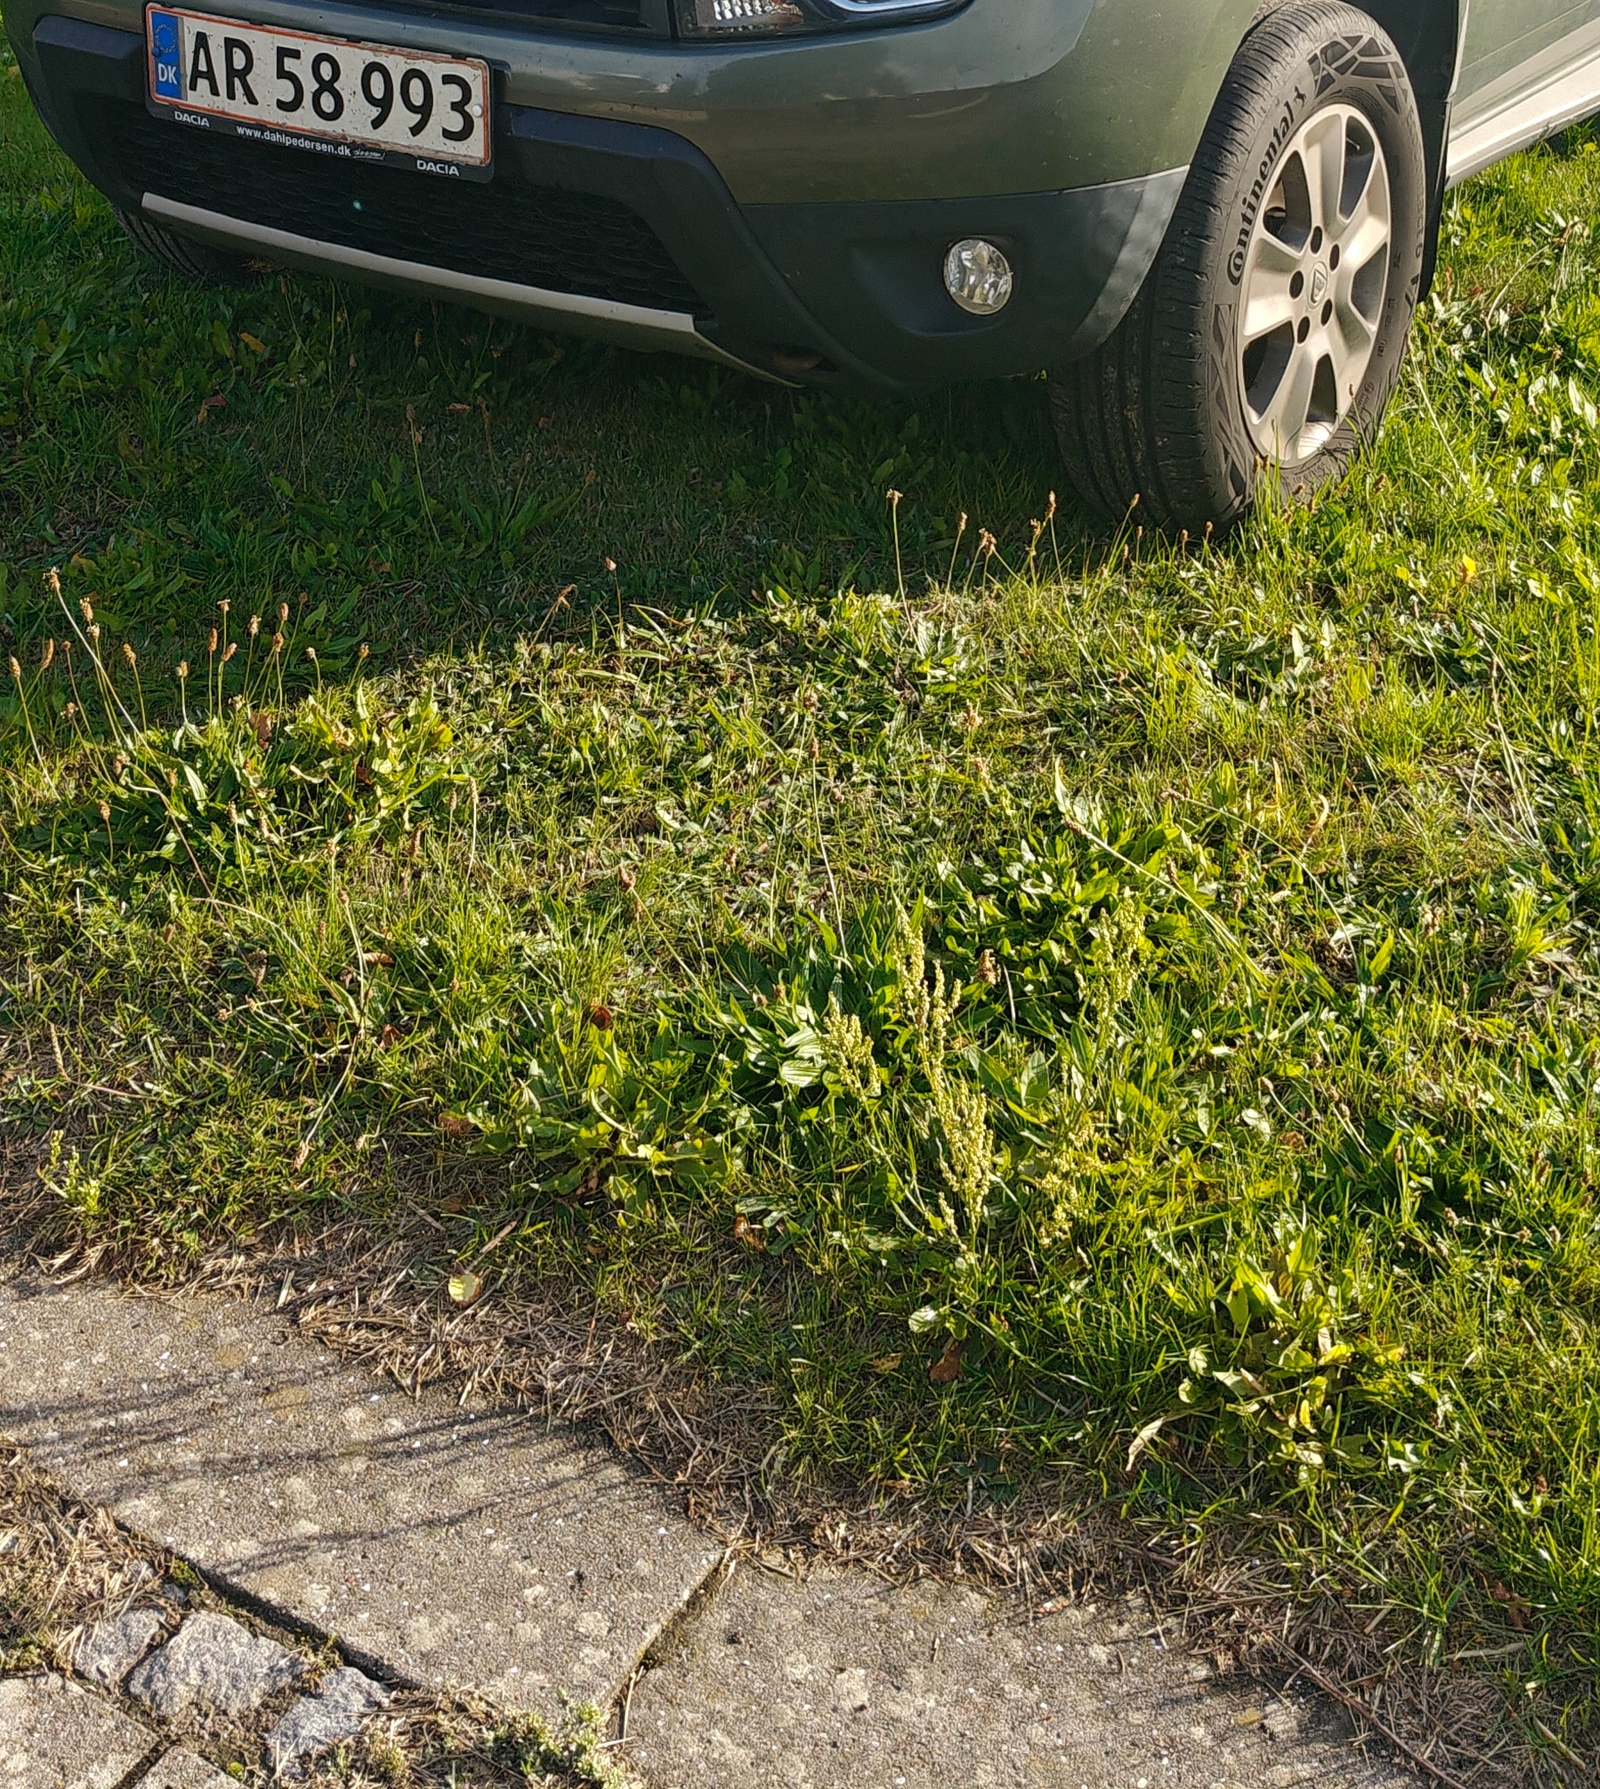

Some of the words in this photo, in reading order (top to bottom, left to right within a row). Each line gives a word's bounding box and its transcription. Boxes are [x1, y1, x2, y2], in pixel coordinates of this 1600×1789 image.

[157, 63, 178, 85] DK
[189, 30, 259, 106] AR
[276, 46, 344, 122] 58
[361, 61, 475, 142] 993
[174, 111, 210, 128] DACIA
[236, 125, 351, 157] www.dahlpedersen.dk
[416, 159, 460, 177] DACIA
[1226, 100, 1294, 286] Continental
